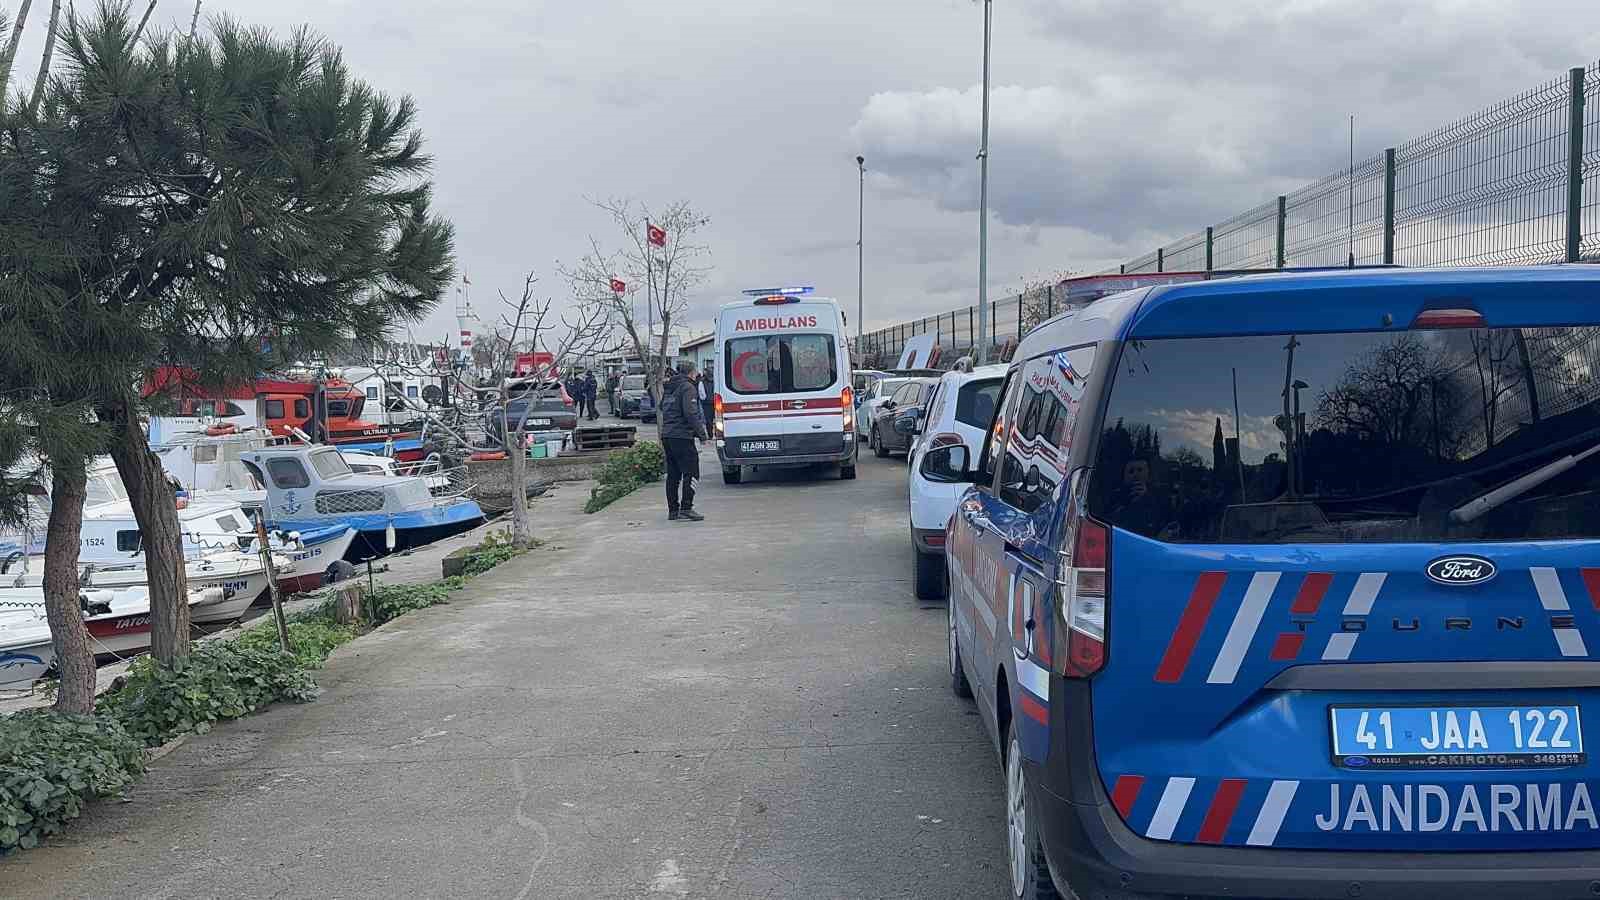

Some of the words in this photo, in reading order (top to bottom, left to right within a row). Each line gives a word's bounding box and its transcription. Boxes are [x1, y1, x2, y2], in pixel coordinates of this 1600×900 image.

[735, 315, 818, 332] AMBULANS
[86, 538, 105, 546] 1524
[1440, 560, 1482, 579] Ford
[1356, 711, 1393, 750] 41
[1420, 710, 1489, 750] JAA
[1508, 709, 1572, 749] 122
[1315, 783, 1600, 833] JANDARMA
